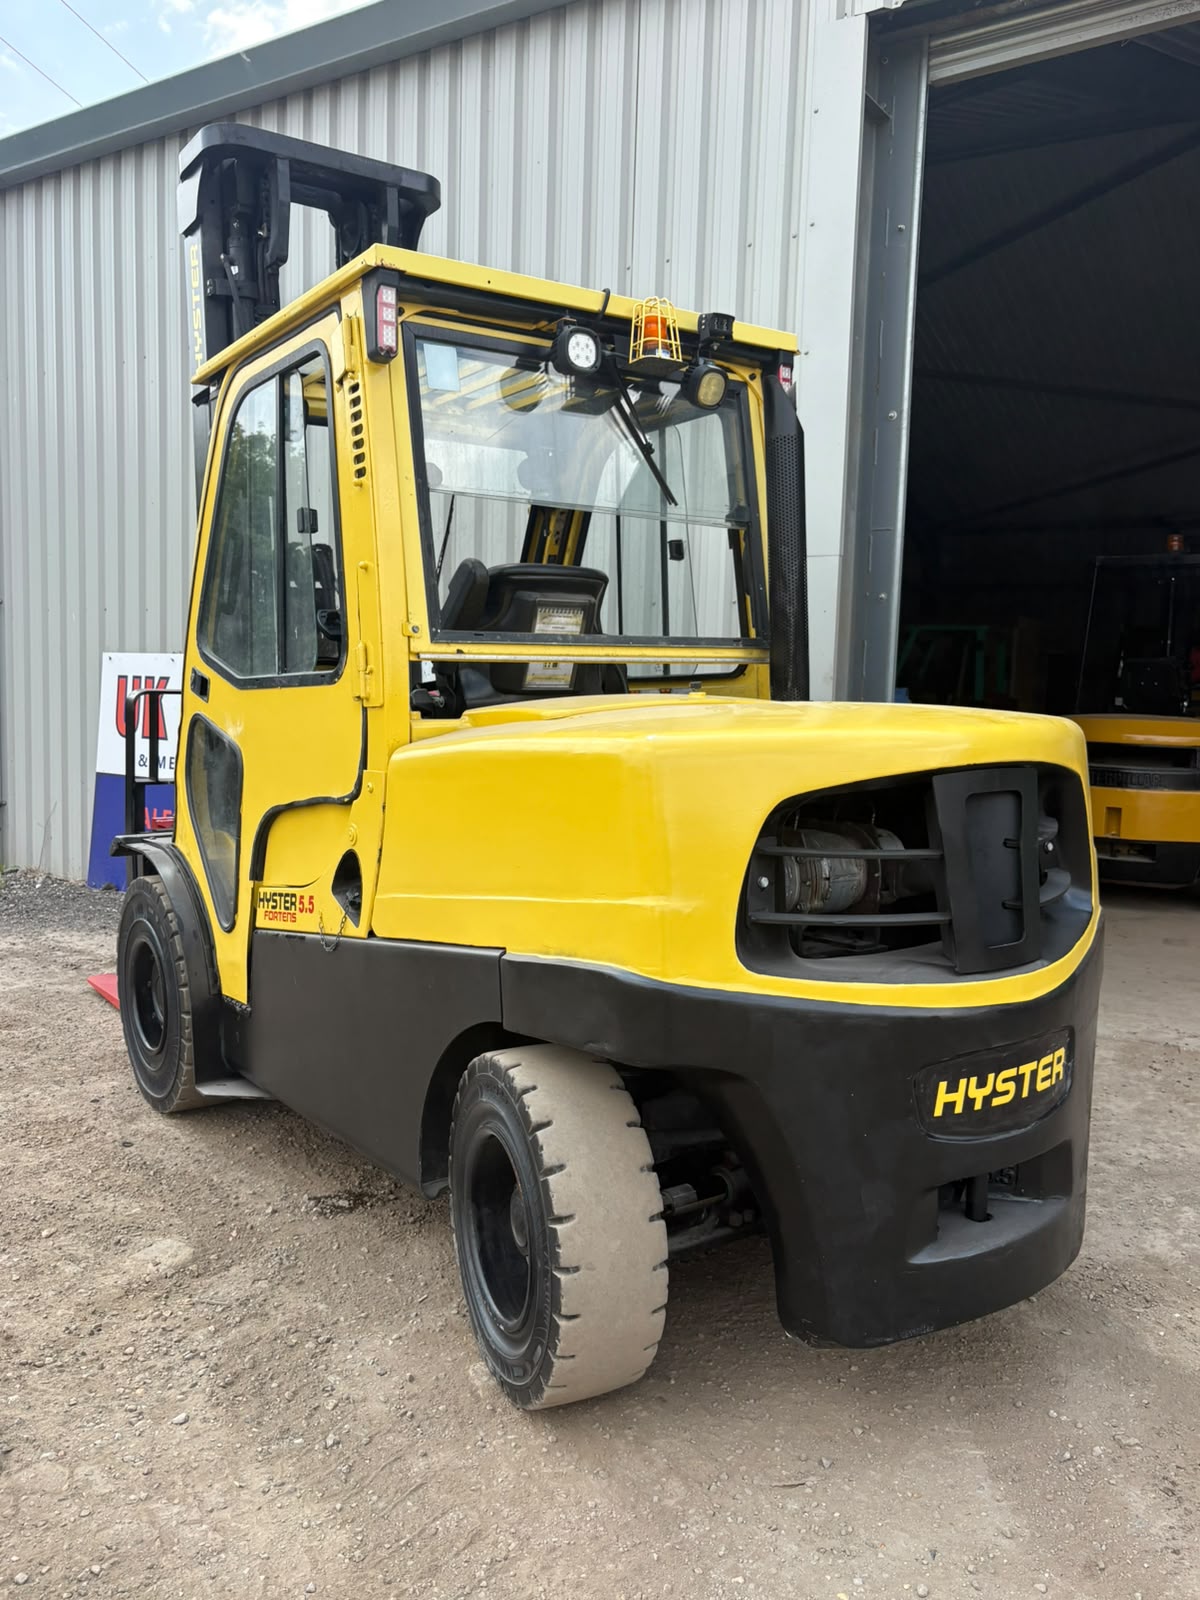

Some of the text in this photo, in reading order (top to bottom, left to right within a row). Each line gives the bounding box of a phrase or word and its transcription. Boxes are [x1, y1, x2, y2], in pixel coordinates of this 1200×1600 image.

[115, 674, 171, 741] UK
[258, 891, 315, 914] HYSTER 5.5
[264, 910, 297, 923] FORTENS
[933, 1046, 1066, 1118] HYSTER
